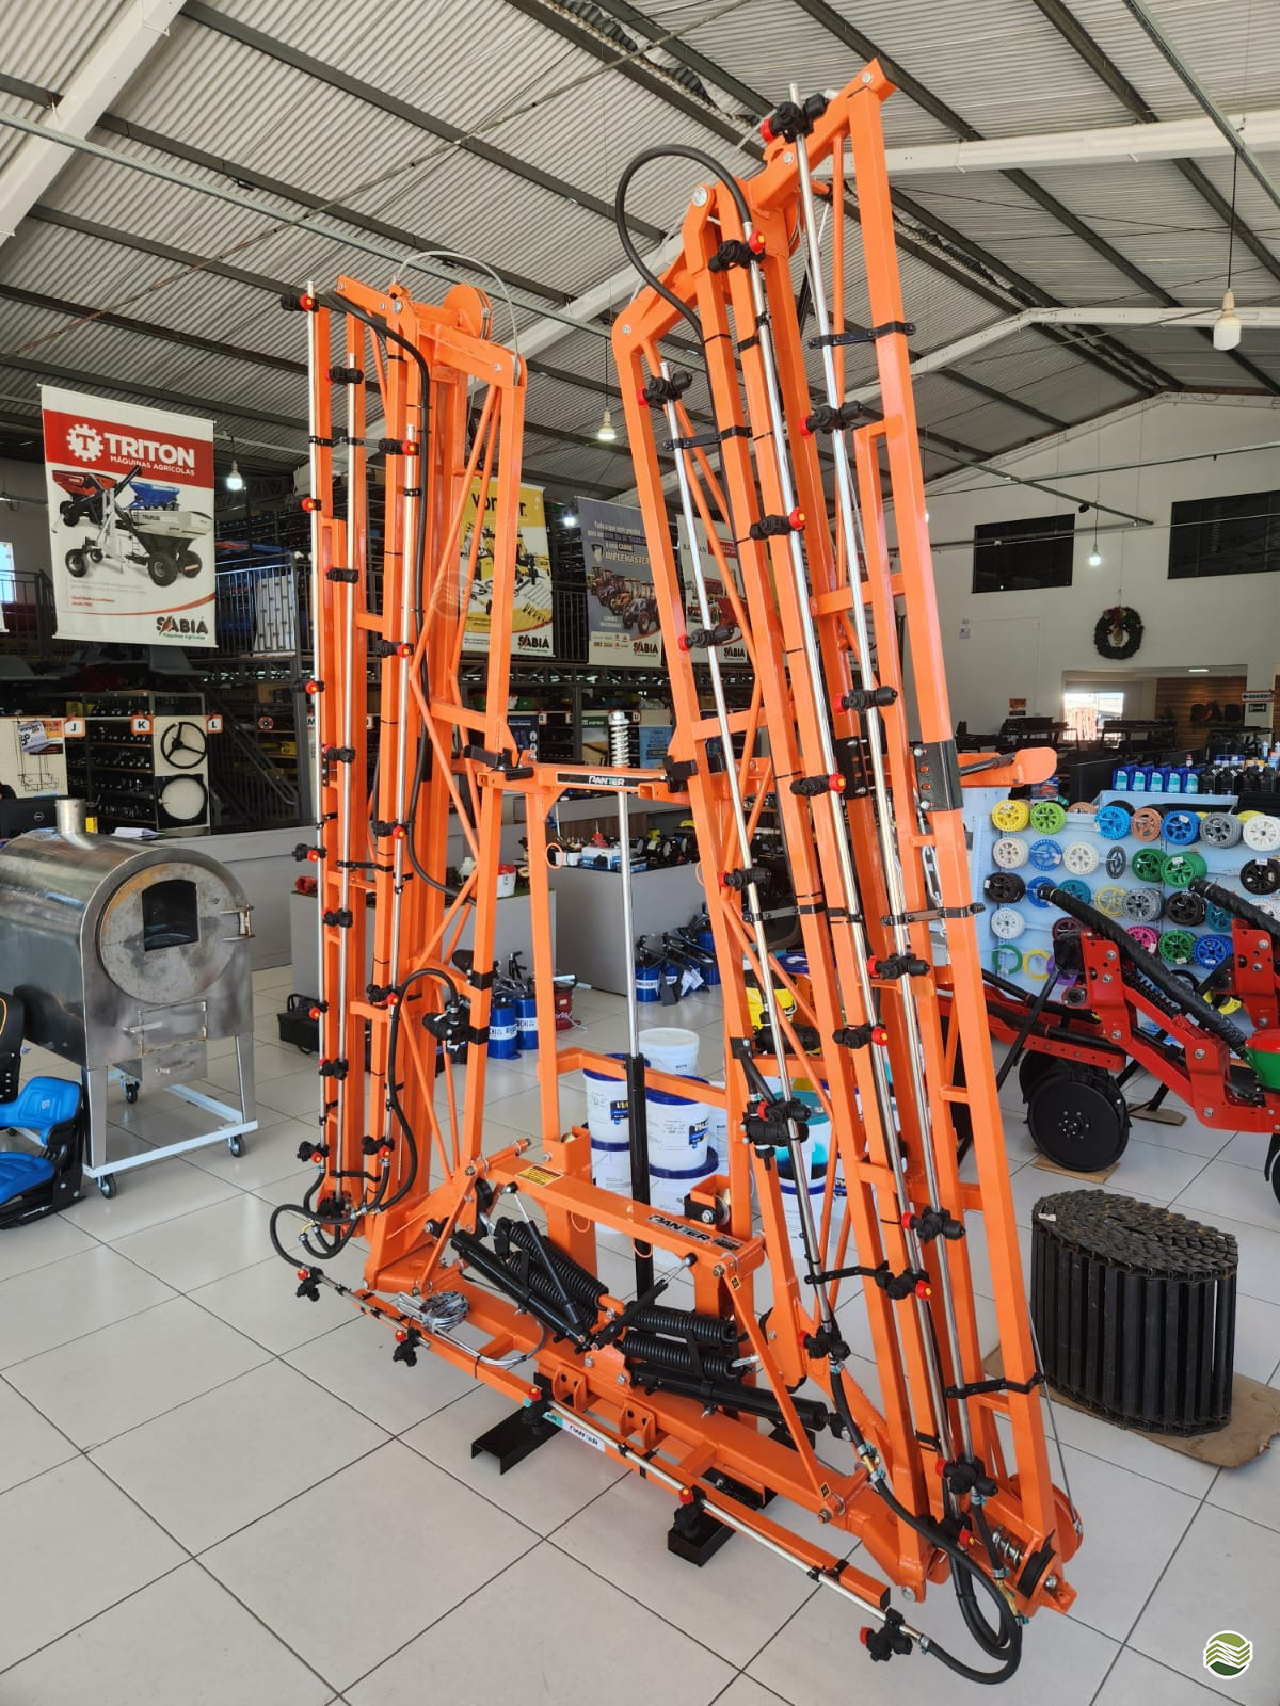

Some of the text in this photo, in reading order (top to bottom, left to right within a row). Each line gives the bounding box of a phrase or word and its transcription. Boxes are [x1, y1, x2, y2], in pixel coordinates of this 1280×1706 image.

[104, 433, 195, 467] TRITON
[70, 722, 77, 731] J
[138, 721, 145, 729] K
[211, 721, 218, 729] L
[648, 1214, 711, 1242] PANTER
